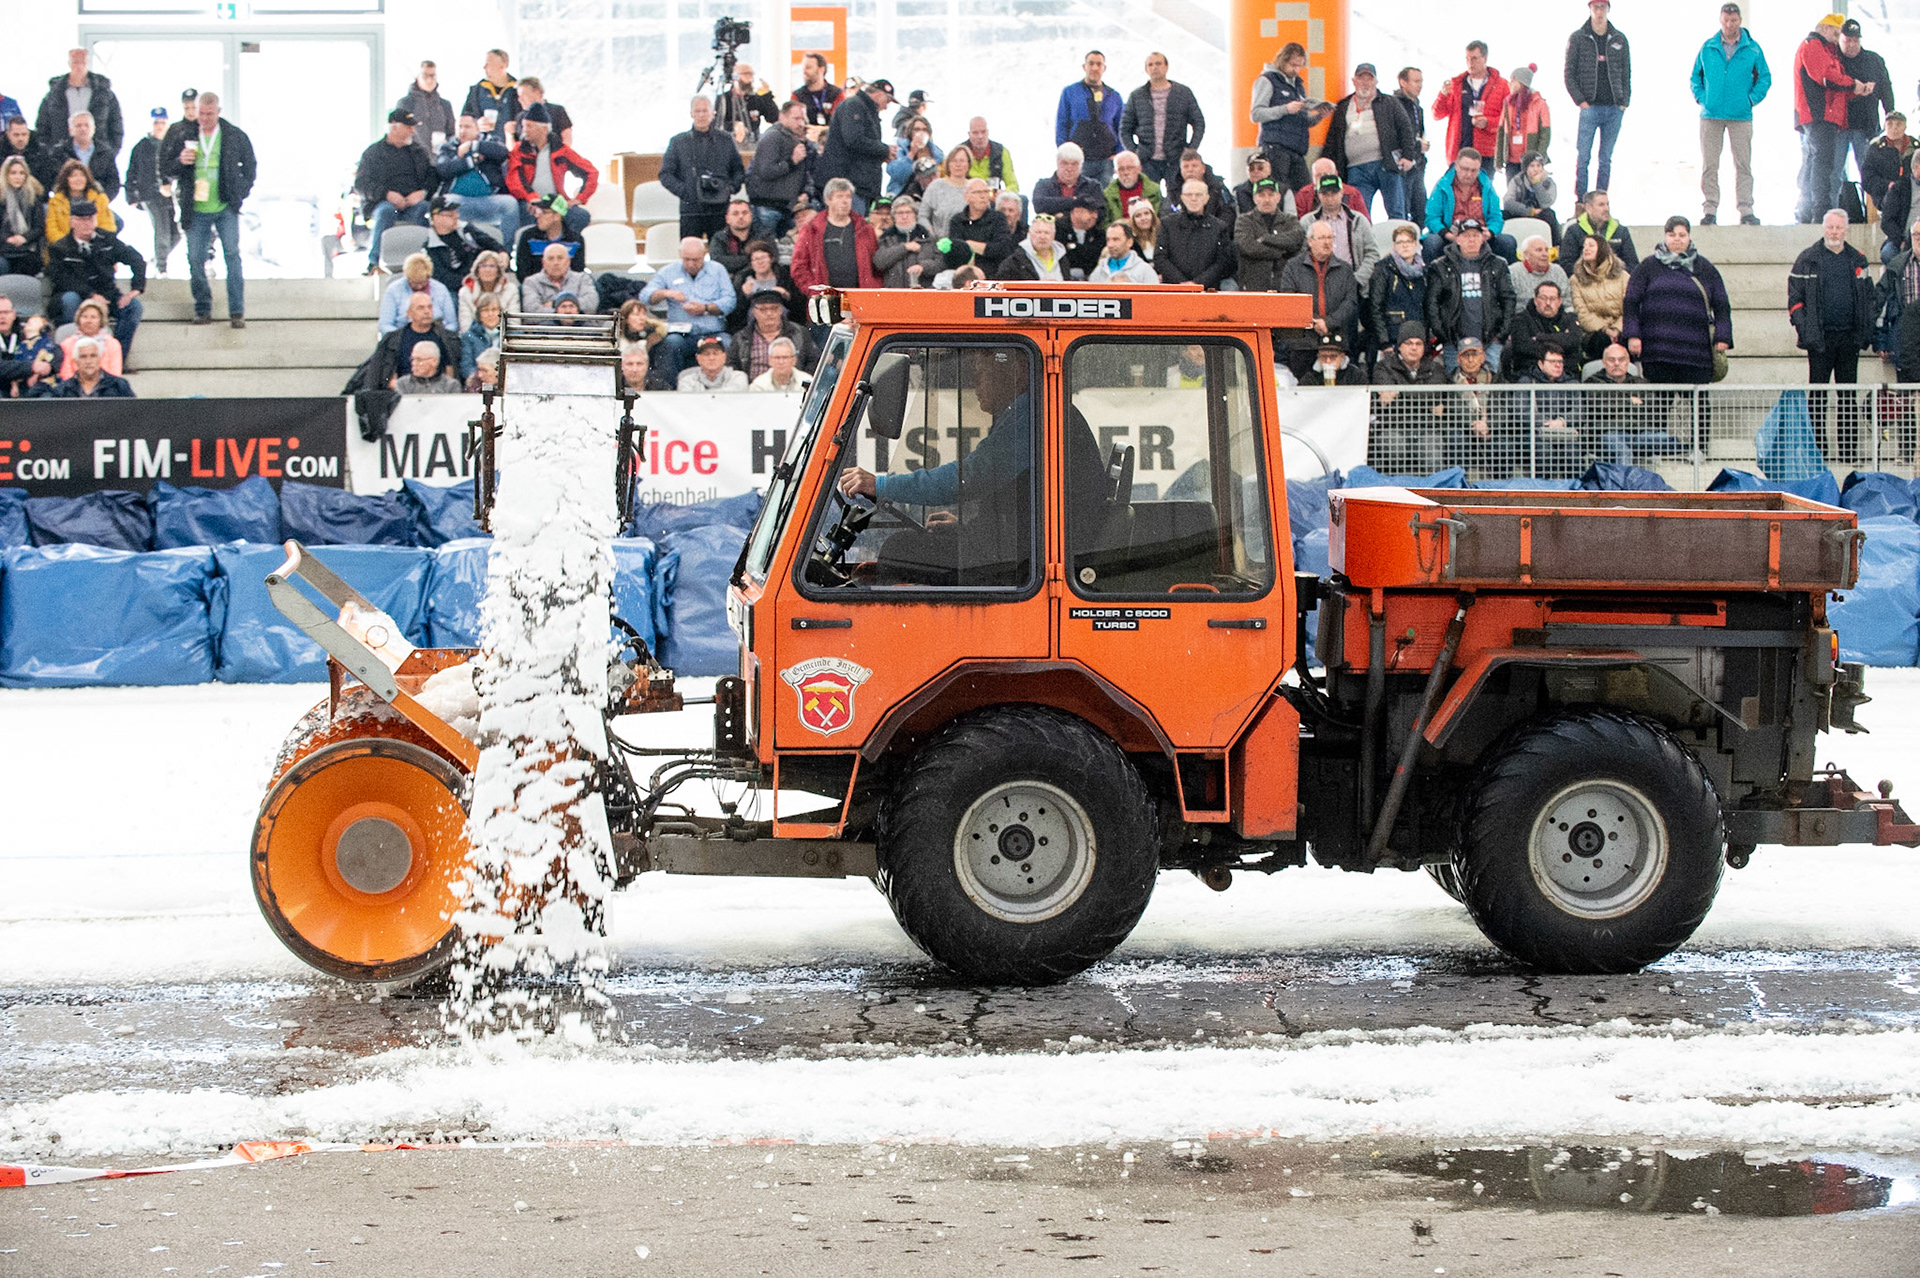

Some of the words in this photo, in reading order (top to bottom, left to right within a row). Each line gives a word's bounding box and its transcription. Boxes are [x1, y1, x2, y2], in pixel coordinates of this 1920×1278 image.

[984, 297, 1121, 318] HOLDER
[1072, 609, 1120, 617] HOLDER
[1096, 621, 1136, 629] TURBO
[791, 658, 831, 676] Gemeinde
[836, 658, 862, 675] Inzell
